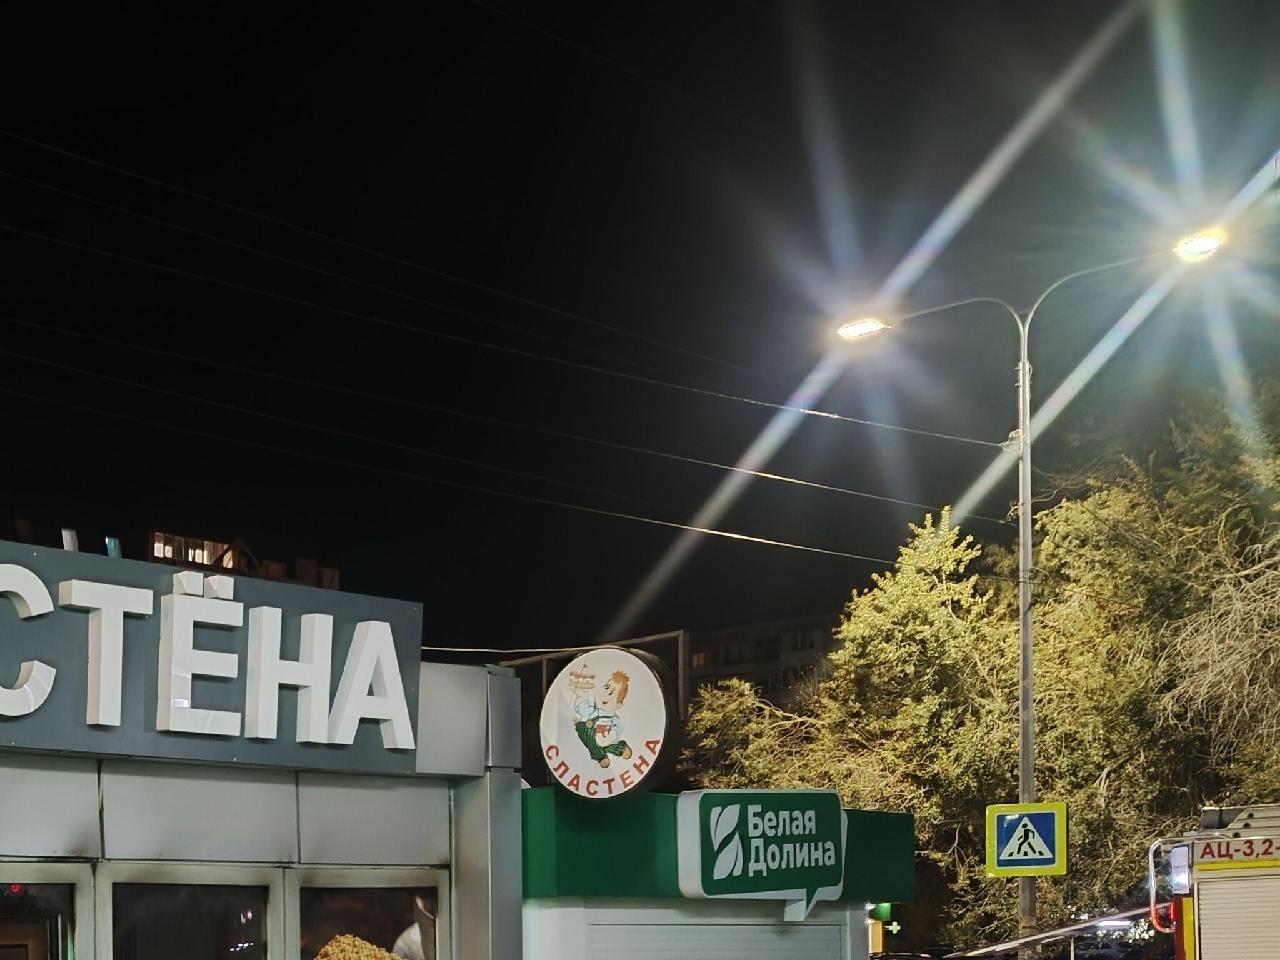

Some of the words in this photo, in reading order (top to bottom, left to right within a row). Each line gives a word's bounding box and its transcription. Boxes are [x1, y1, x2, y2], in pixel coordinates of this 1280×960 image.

[544, 738, 661, 797] СЛАСТЕНА
[747, 803, 817, 837] Белая
[748, 837, 837, 877] Долина
